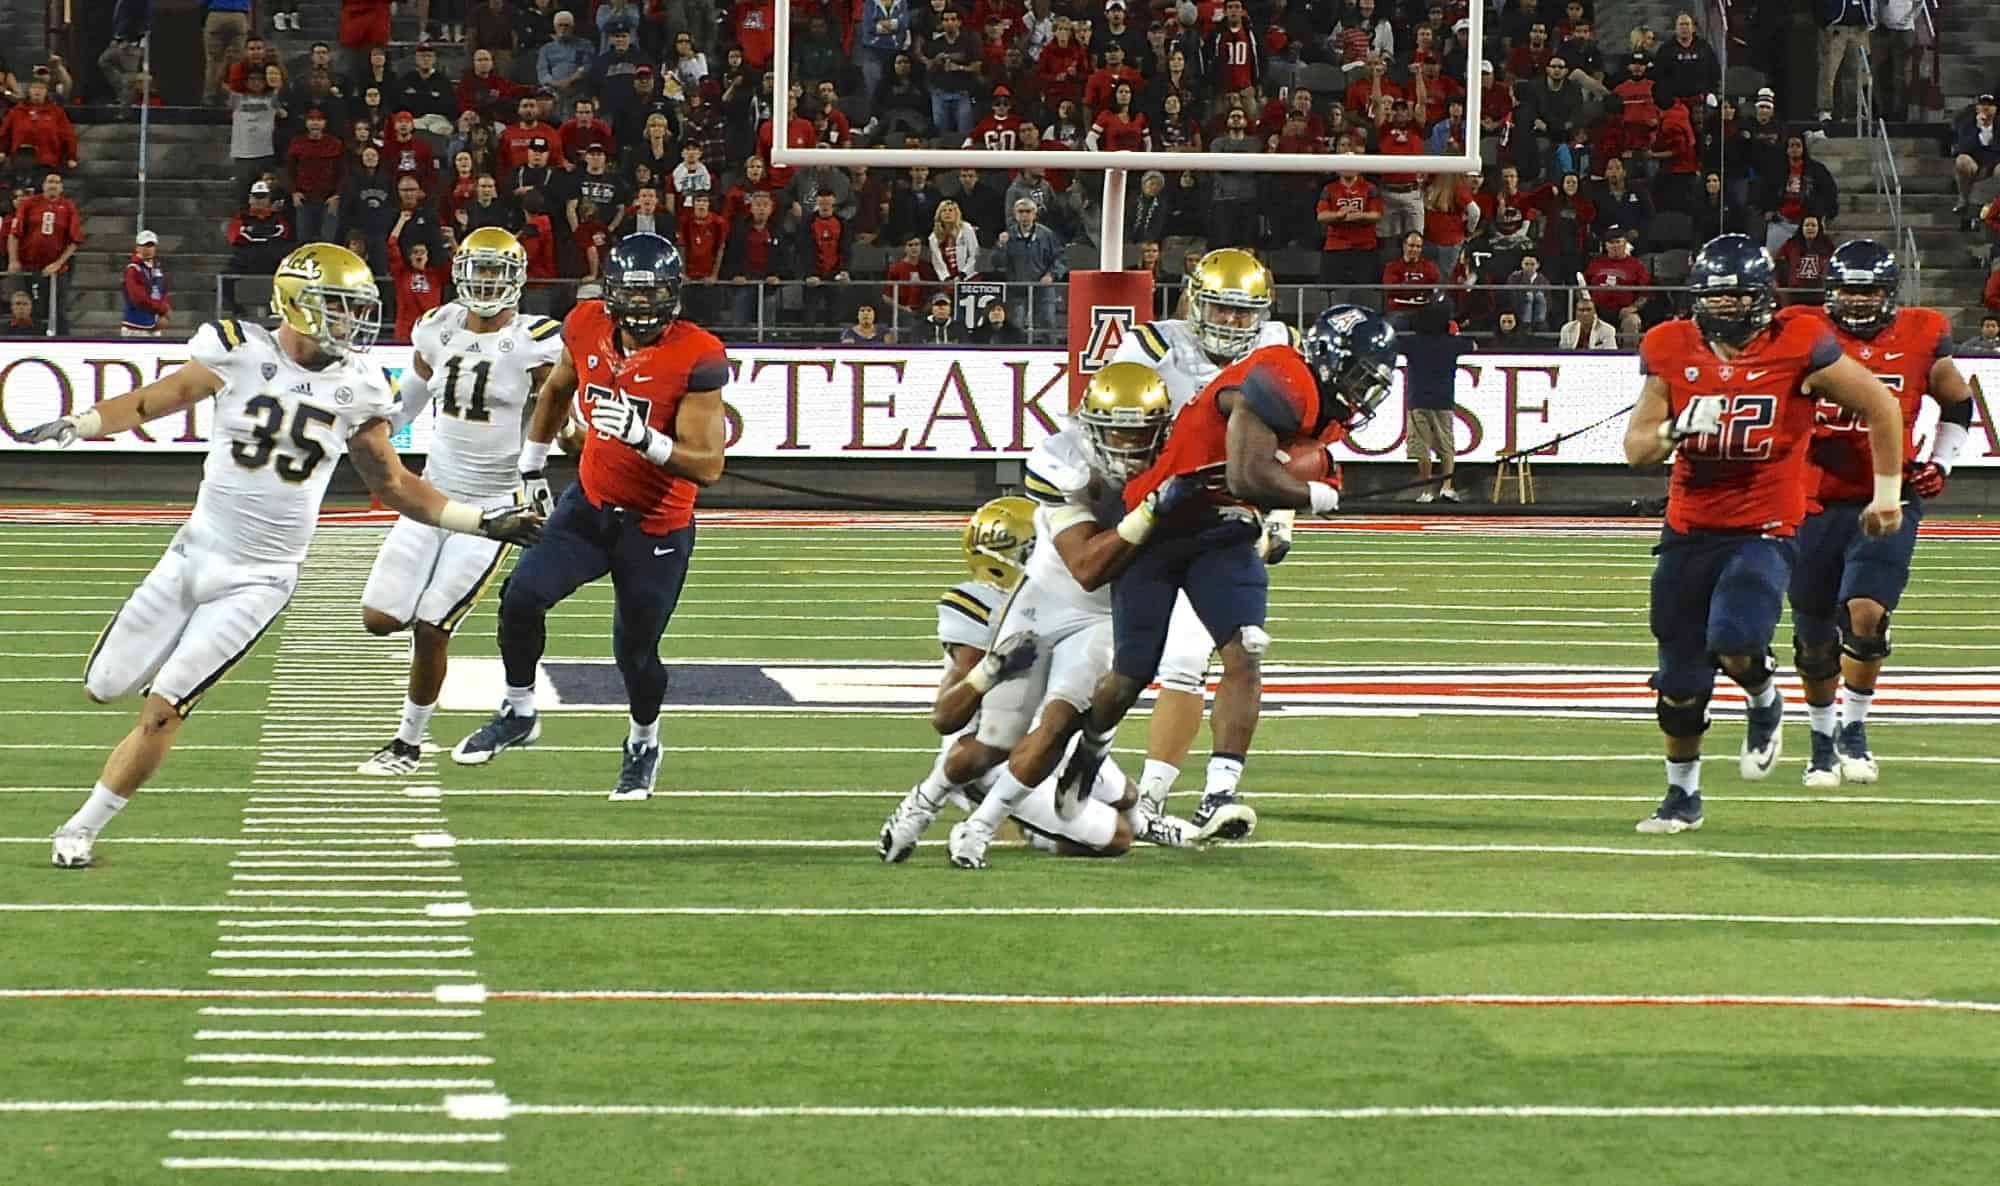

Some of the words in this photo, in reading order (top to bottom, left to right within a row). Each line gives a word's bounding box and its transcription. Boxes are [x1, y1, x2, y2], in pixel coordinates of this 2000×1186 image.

[1224, 41, 1248, 65] 10
[441, 353, 492, 423] 11
[231, 395, 337, 485] 35
